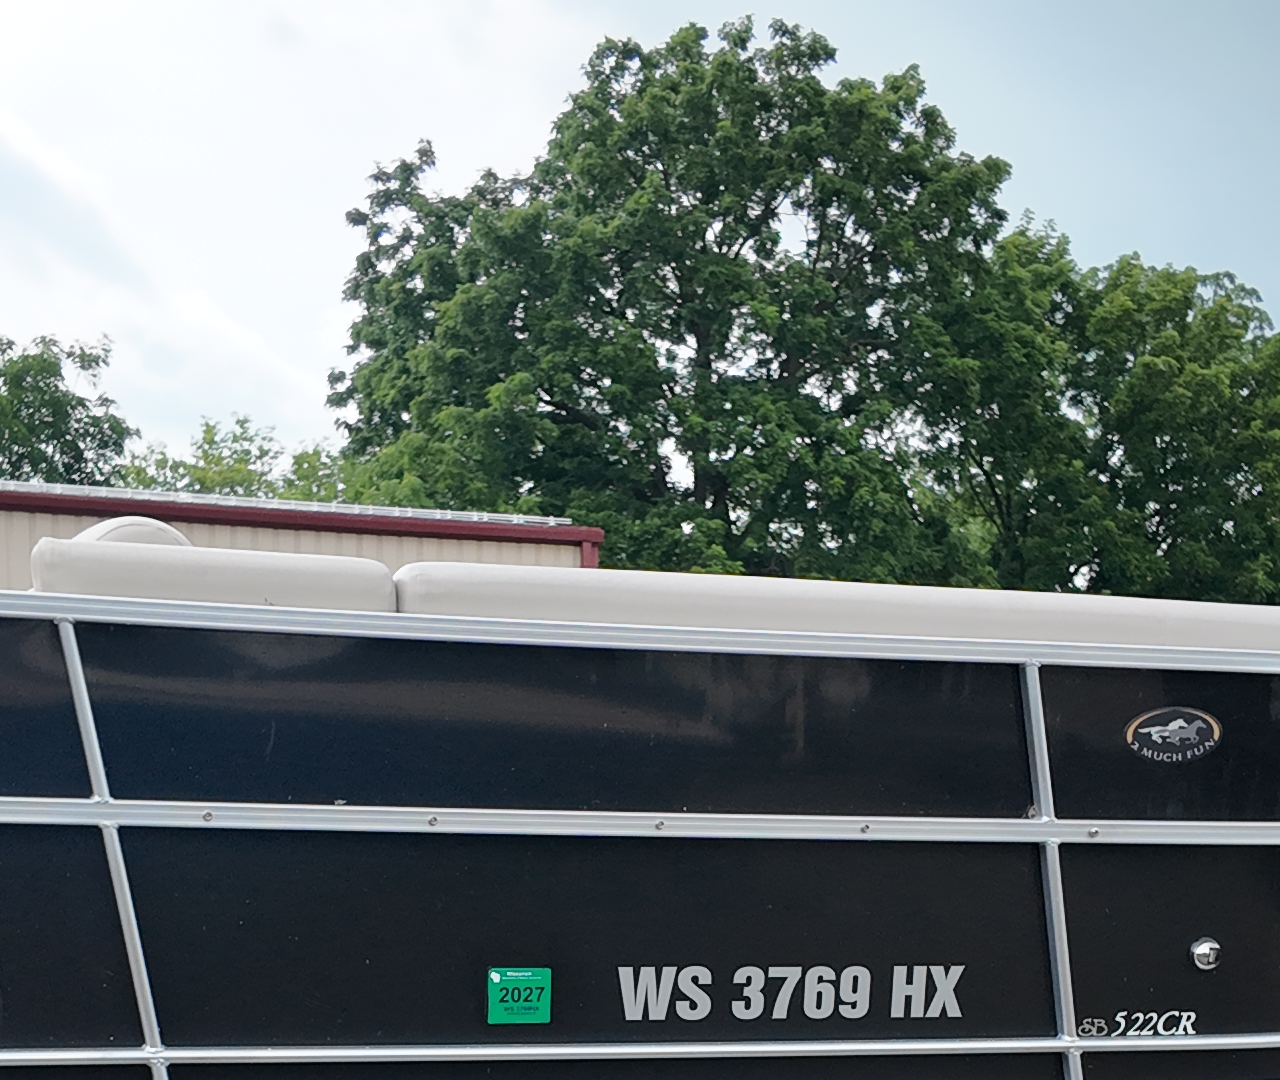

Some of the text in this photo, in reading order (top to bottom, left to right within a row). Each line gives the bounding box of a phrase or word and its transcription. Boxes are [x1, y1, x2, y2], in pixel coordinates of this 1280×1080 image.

[1140, 747, 1182, 762] MUCH
[1186, 738, 1215, 759] FUN
[498, 986, 545, 1003] 2027
[617, 964, 966, 1021] WS 3769 HX
[1111, 1010, 1197, 1037] 522CR
